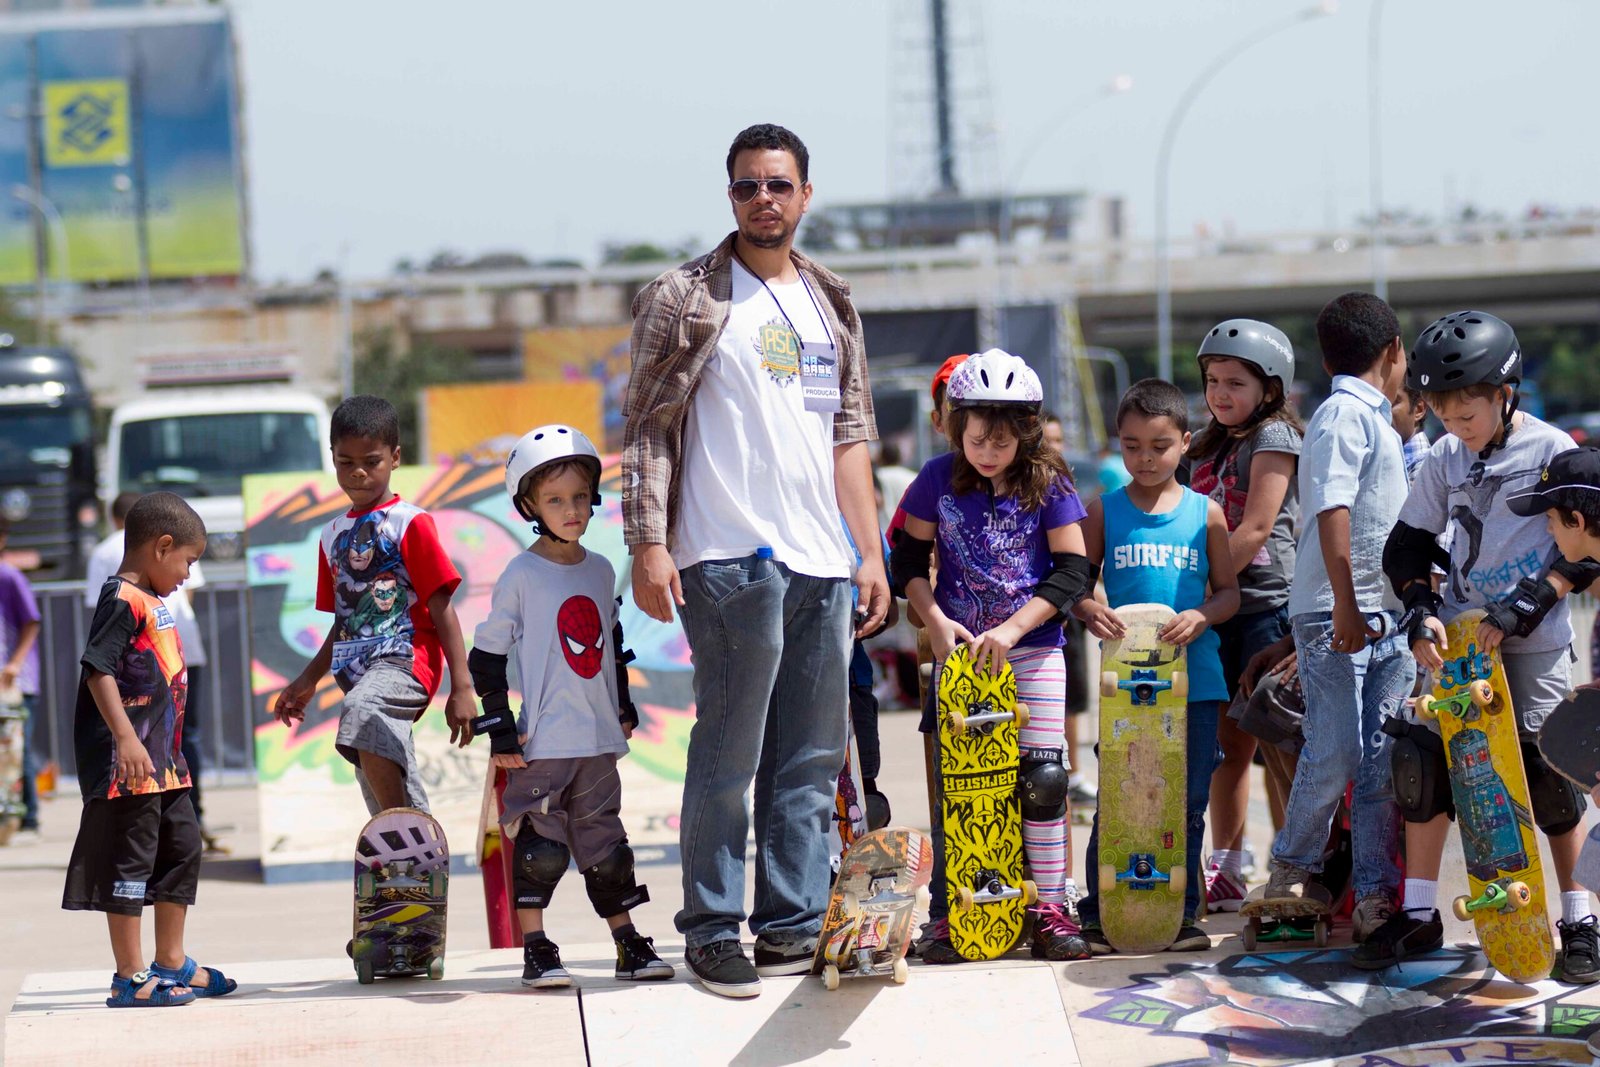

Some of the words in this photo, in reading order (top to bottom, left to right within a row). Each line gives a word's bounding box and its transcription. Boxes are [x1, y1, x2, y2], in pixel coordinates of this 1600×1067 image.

[1500, 350, 1517, 375] URGH
[803, 365, 832, 374] BASE
[805, 388, 837, 397] PRODUÇÃO
[1114, 543, 1173, 569] SURF
[1033, 750, 1058, 760] LAZER
